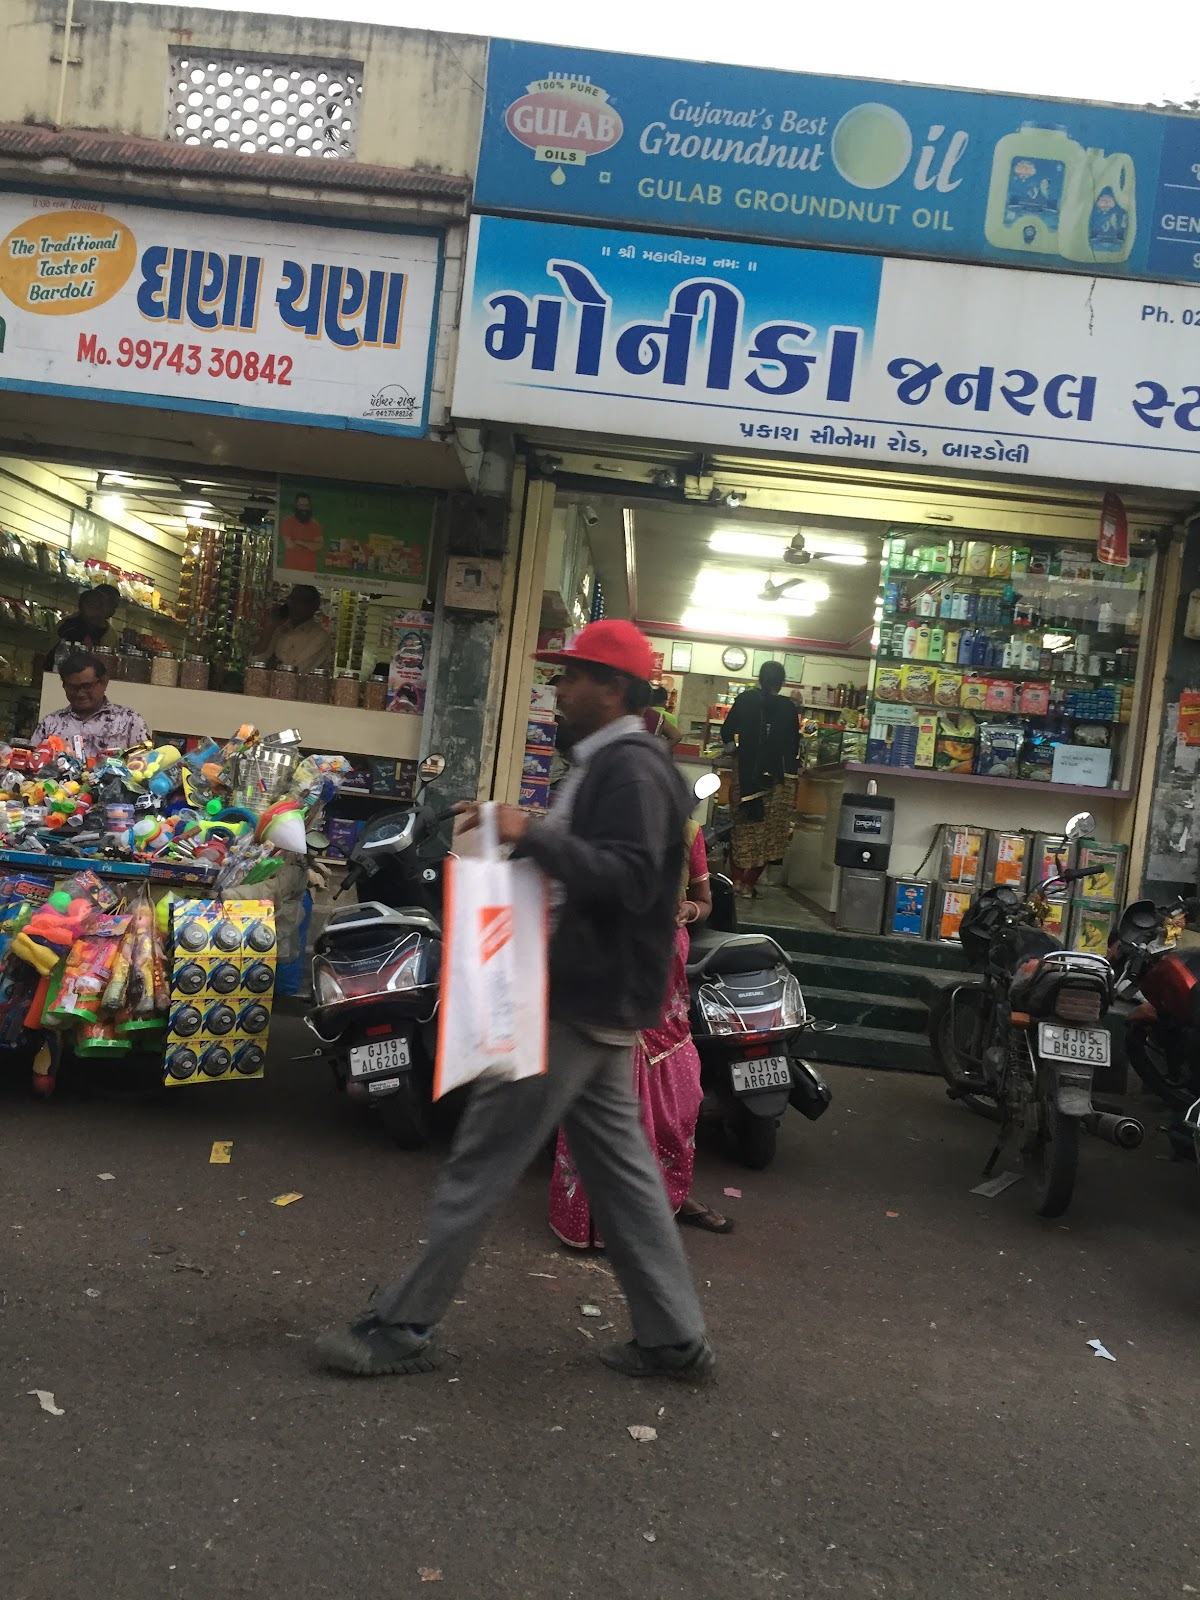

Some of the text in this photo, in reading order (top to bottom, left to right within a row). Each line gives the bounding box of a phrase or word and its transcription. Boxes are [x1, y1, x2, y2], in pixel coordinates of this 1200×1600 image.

[537, 81, 600, 97] 100% PURE
[513, 105, 617, 142] GULAB
[669, 98, 830, 136] Gujarat's Best
[544, 150, 577, 162] OILS
[639, 121, 826, 172] Groundnut
[637, 177, 954, 232] GULAB GROUNDNUT OIL
[11, 233, 119, 255] The Traditional
[617, 245, 636, 259] શ્રી
[642, 249, 706, 267] મહાવીરાય
[40, 257, 97, 277] Taste of
[29, 280, 96, 301] Bardoli
[137, 245, 407, 351] દાણા ચણા
[1141, 304, 1175, 324] Ph.
[484, 260, 860, 402] મોનીકા
[886, 357, 1097, 422] જનરલ
[77, 333, 293, 386] Mo. 99743 30842
[739, 421, 1030, 464] પ્રકાશ સીનેમા રોડ, બારડોલી
[1062, 1028, 1095, 1045] GJ05
[367, 1041, 398, 1058] GJ19
[1053, 1041, 1104, 1060] BM9825
[362, 1052, 406, 1073] AL6209
[748, 1058, 778, 1074] GJ19
[744, 1070, 788, 1089] AR6209
